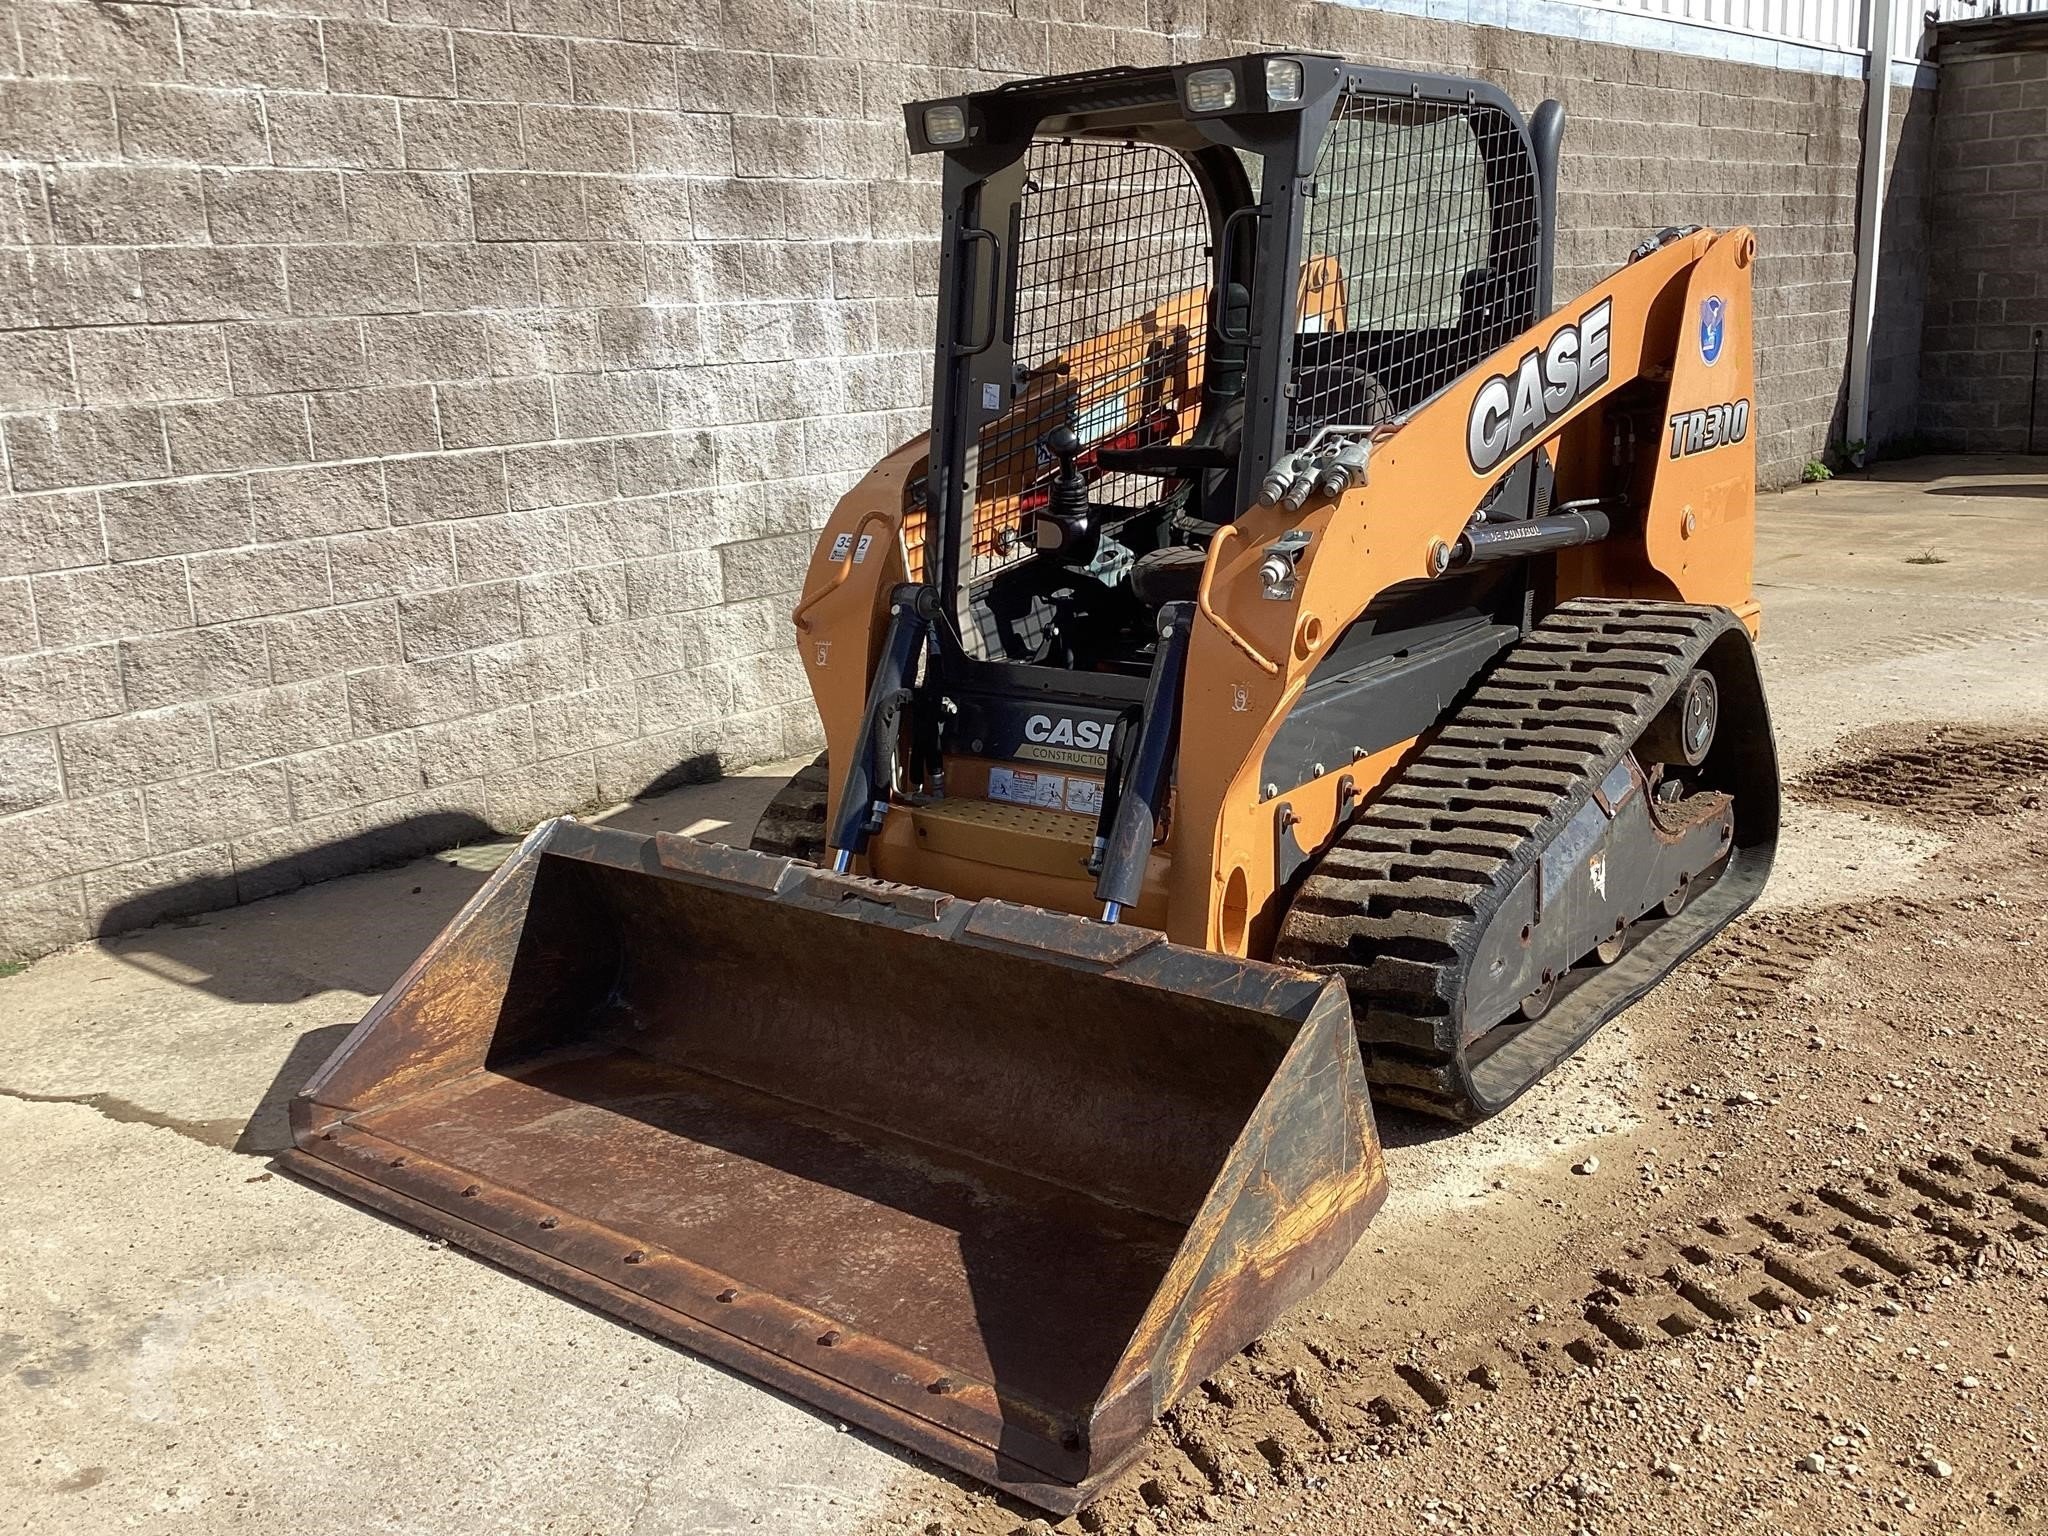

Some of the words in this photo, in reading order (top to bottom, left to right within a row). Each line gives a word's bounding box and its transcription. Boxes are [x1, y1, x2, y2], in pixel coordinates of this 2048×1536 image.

[1468, 298, 1611, 471] CASE
[1670, 398, 1750, 460] TR310
[837, 536, 868, 549] 352
